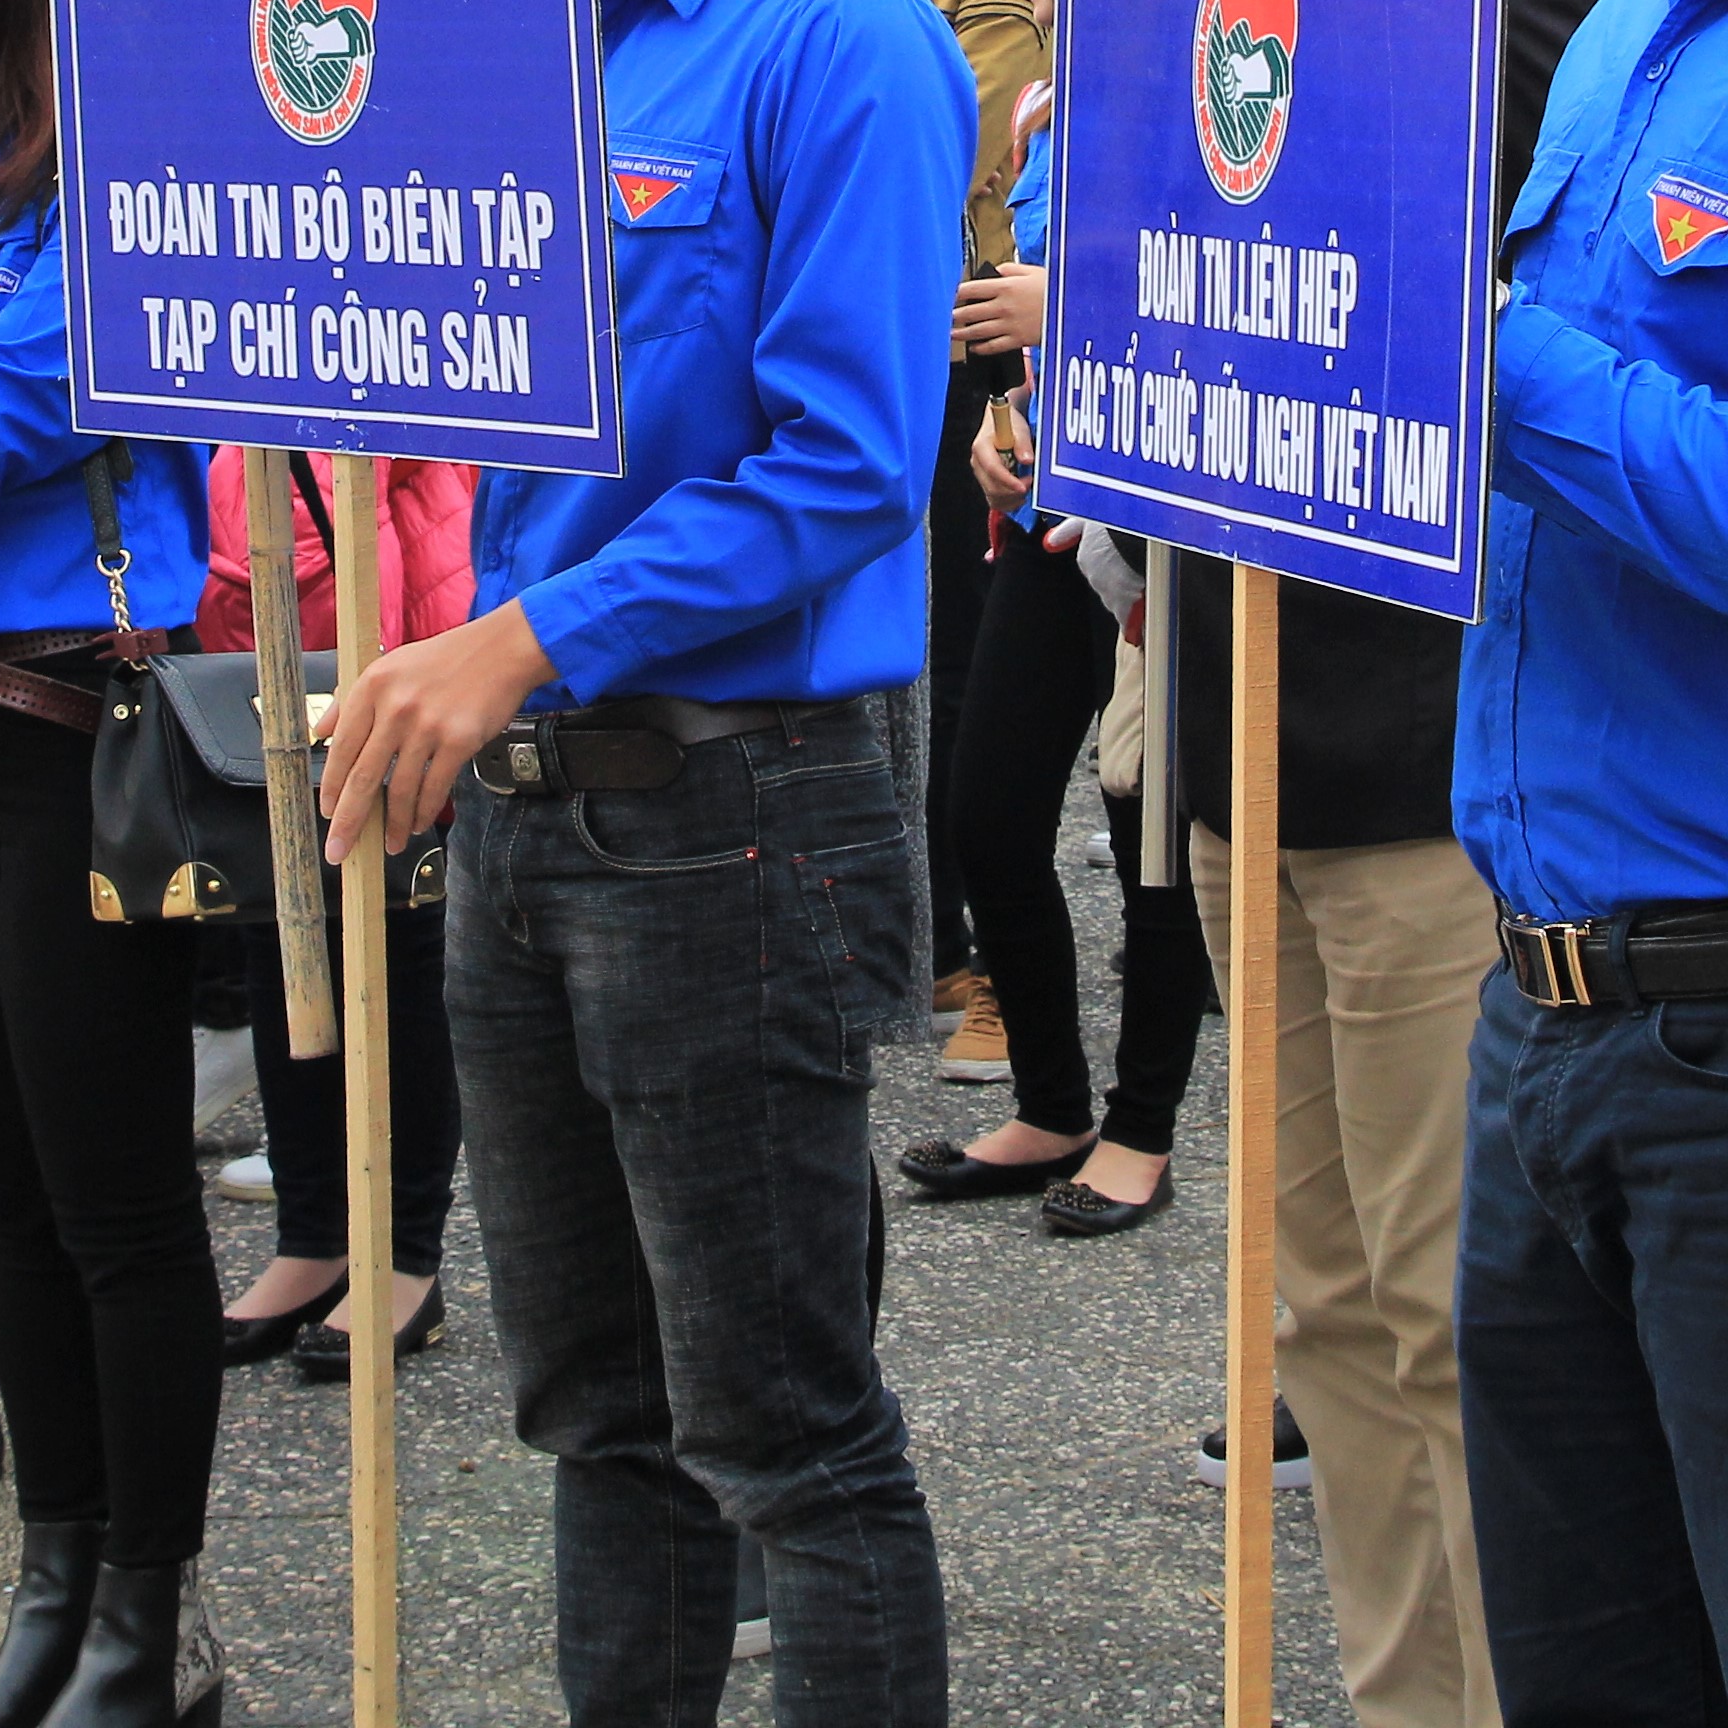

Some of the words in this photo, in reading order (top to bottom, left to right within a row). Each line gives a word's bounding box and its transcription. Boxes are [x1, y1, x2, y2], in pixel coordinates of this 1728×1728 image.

[108, 165, 219, 257] ĐOÀN
[226, 182, 282, 260] TN
[291, 168, 352, 279] BỘ
[362, 170, 464, 267] BIÊN
[472, 172, 556, 287] TẬP
[1703, 196, 1726, 213] VIỆT
[142, 297, 217, 388] TẠP
[228, 287, 300, 380] CHÍ
[310, 290, 430, 401] CỘNG
[440, 278, 532, 395] SẢN
[1138, 211, 1197, 326] ĐOÀN
[1236, 222, 1292, 341] LIÊN
[1297, 229, 1359, 370] HIỆP
[1065, 340, 1106, 450] CÁC
[1111, 332, 1139, 457] TỔ
[1140, 350, 1198, 472] CHỨC
[1202, 362, 1250, 484] HỮU
[1255, 393, 1316, 520] NGHỊ
[1322, 388, 1378, 530] VIỆT
[1382, 416, 1451, 528] NAM
